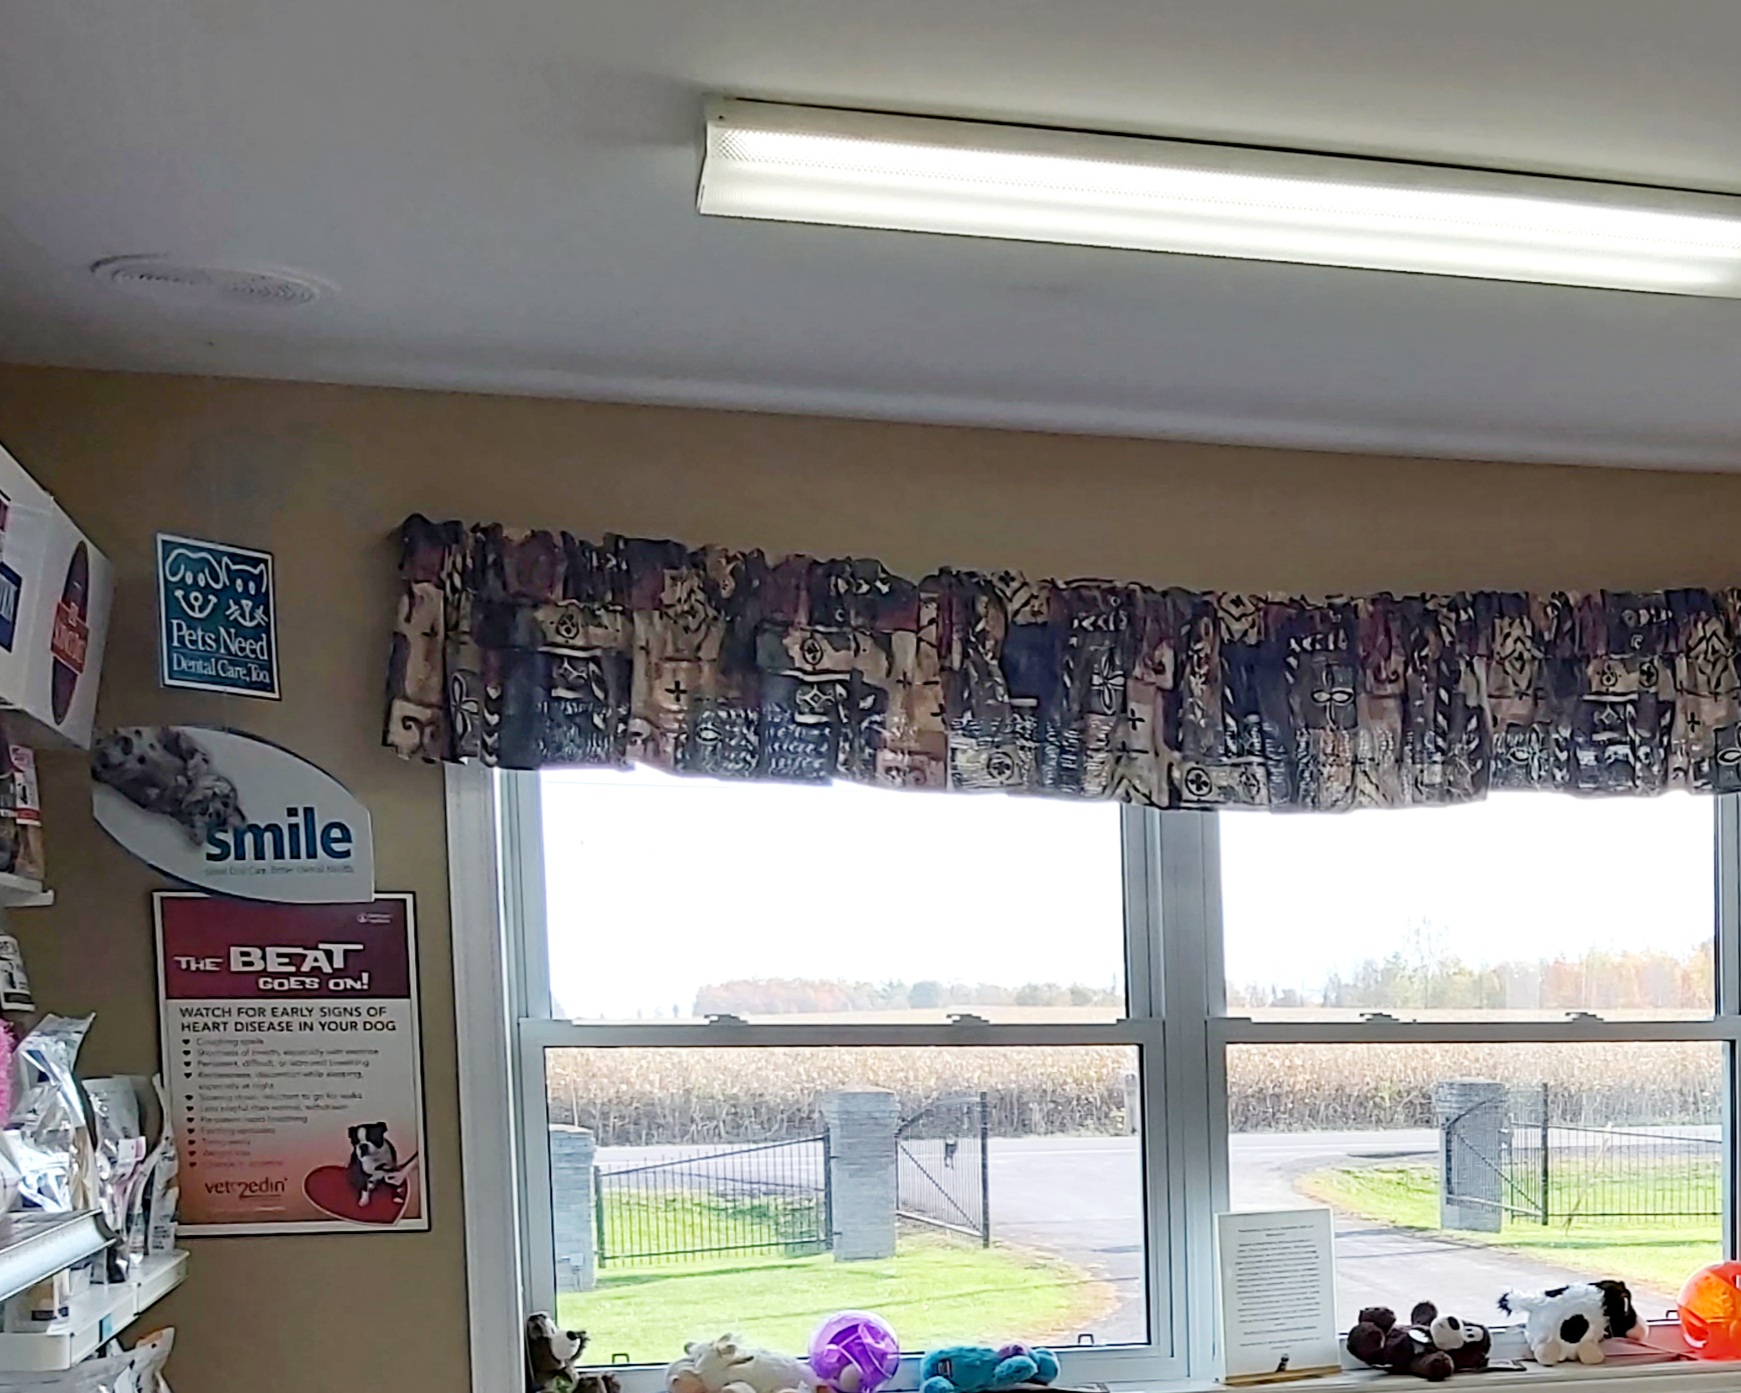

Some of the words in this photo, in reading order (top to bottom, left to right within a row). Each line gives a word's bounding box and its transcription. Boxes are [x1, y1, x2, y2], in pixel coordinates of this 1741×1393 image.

[171, 619, 216, 652] Pets
[219, 626, 269, 661] Need
[173, 653, 216, 675] Dental
[206, 807, 353, 862] smile
[174, 956, 223, 972] THE
[230, 943, 364, 974] BEAT
[258, 976, 320, 991] GOES
[328, 972, 370, 991] ON!
[179, 1006, 232, 1019] WATCH
[236, 1006, 267, 1018] FOR
[271, 1006, 314, 1018] EARLY
[319, 1006, 362, 1018] SIGNS
[366, 1006, 388, 1018] OF
[181, 1021, 229, 1034] HEART
[234, 1021, 294, 1033] DISEASE
[299, 1021, 314, 1032] IN
[318, 1021, 358, 1032] YOUR
[363, 1020, 397, 1032] DOG
